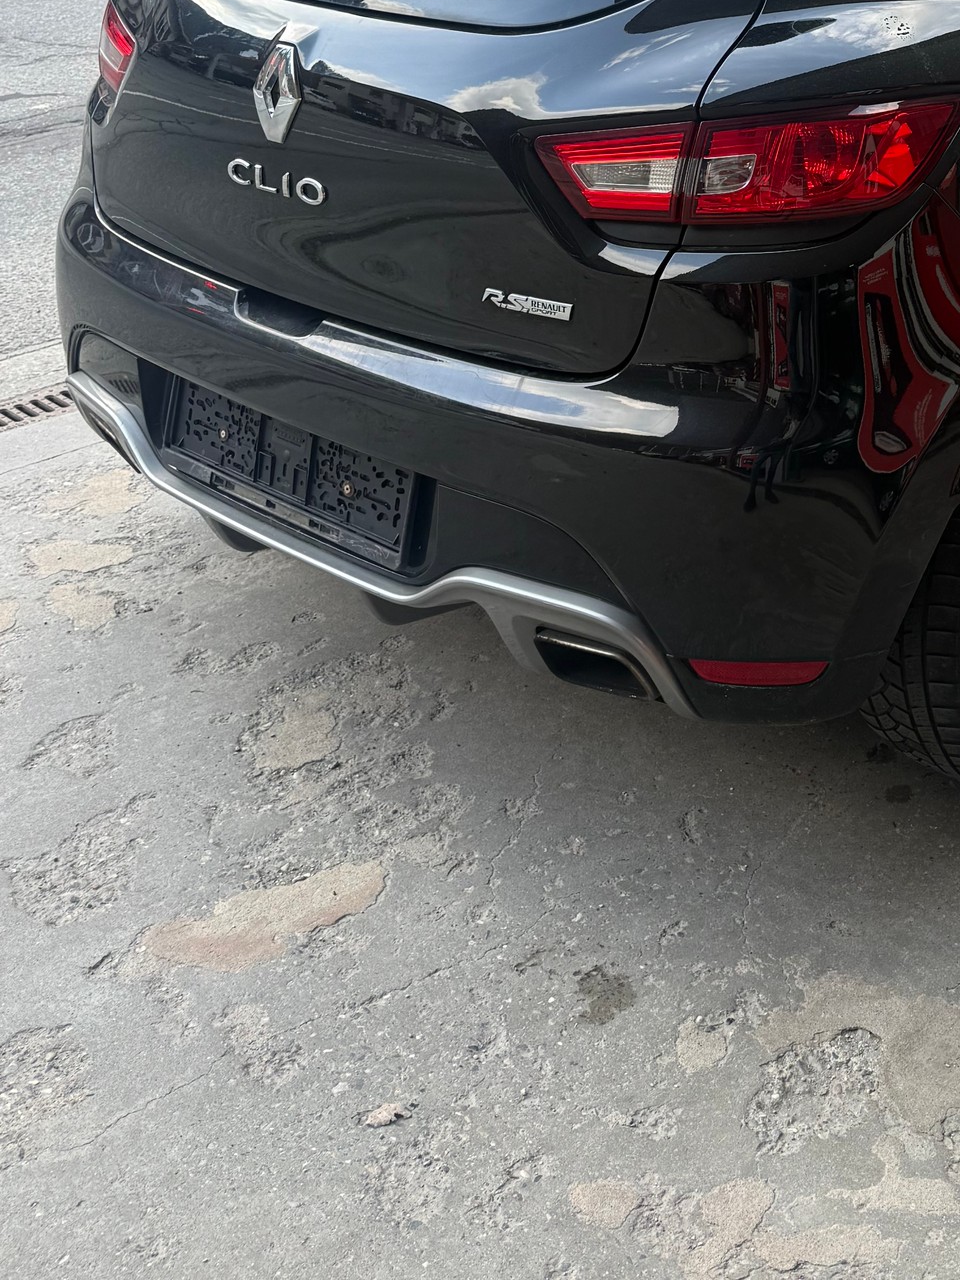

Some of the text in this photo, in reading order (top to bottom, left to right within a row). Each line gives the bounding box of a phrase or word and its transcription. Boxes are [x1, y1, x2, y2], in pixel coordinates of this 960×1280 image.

[227, 157, 327, 206] CLIO
[530, 300, 567, 314] RENAULT
[530, 308, 558, 317] SPORT
